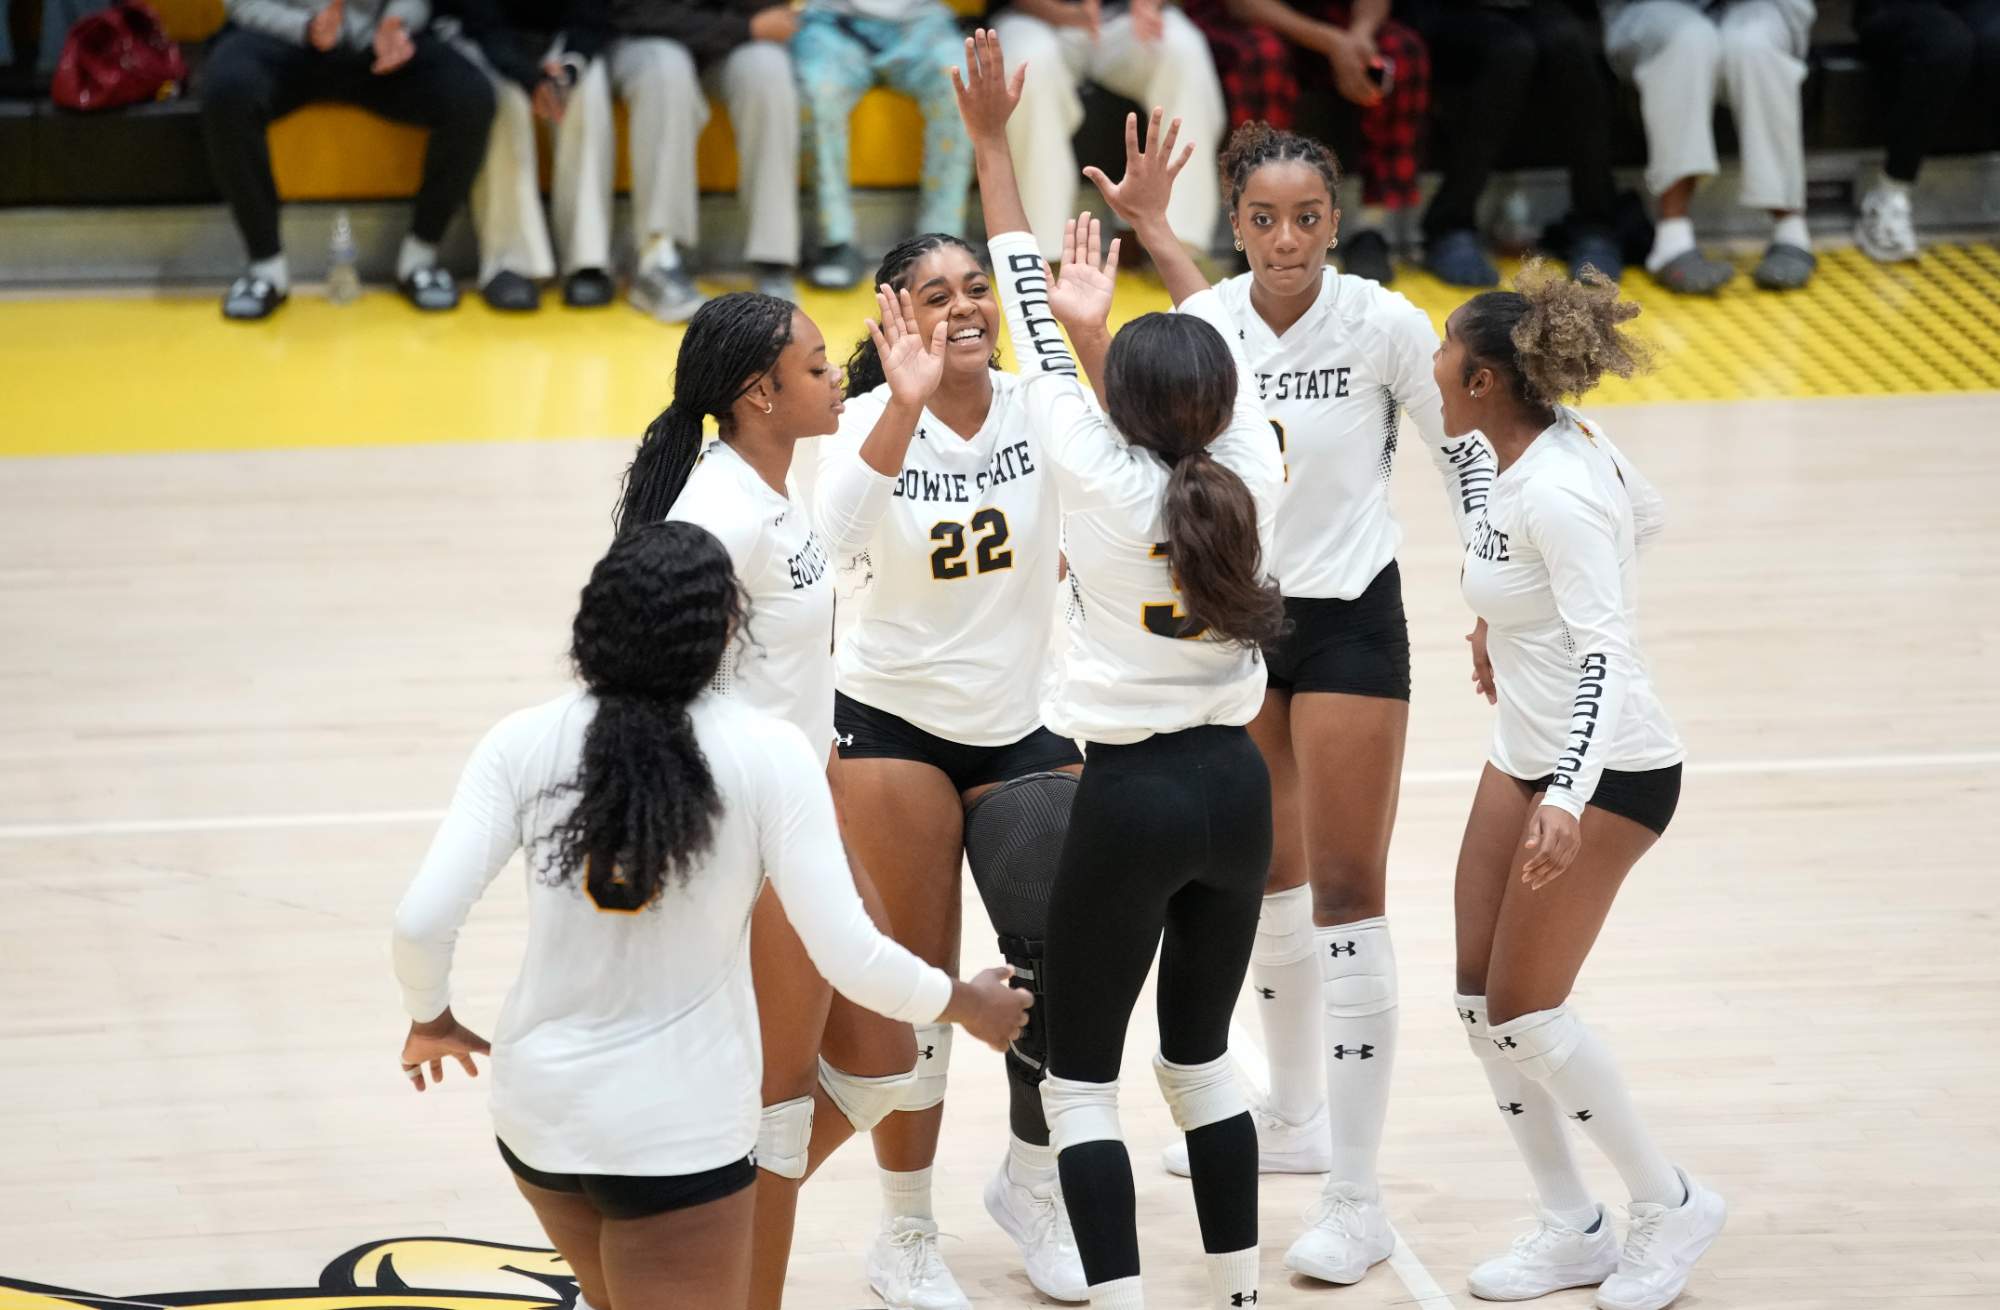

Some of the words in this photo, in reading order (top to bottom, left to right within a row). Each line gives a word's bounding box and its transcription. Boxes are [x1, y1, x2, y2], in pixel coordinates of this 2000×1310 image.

[1275, 367, 1351, 400] STATE
[976, 440, 1035, 494] SATE
[930, 506, 1014, 580] 22
